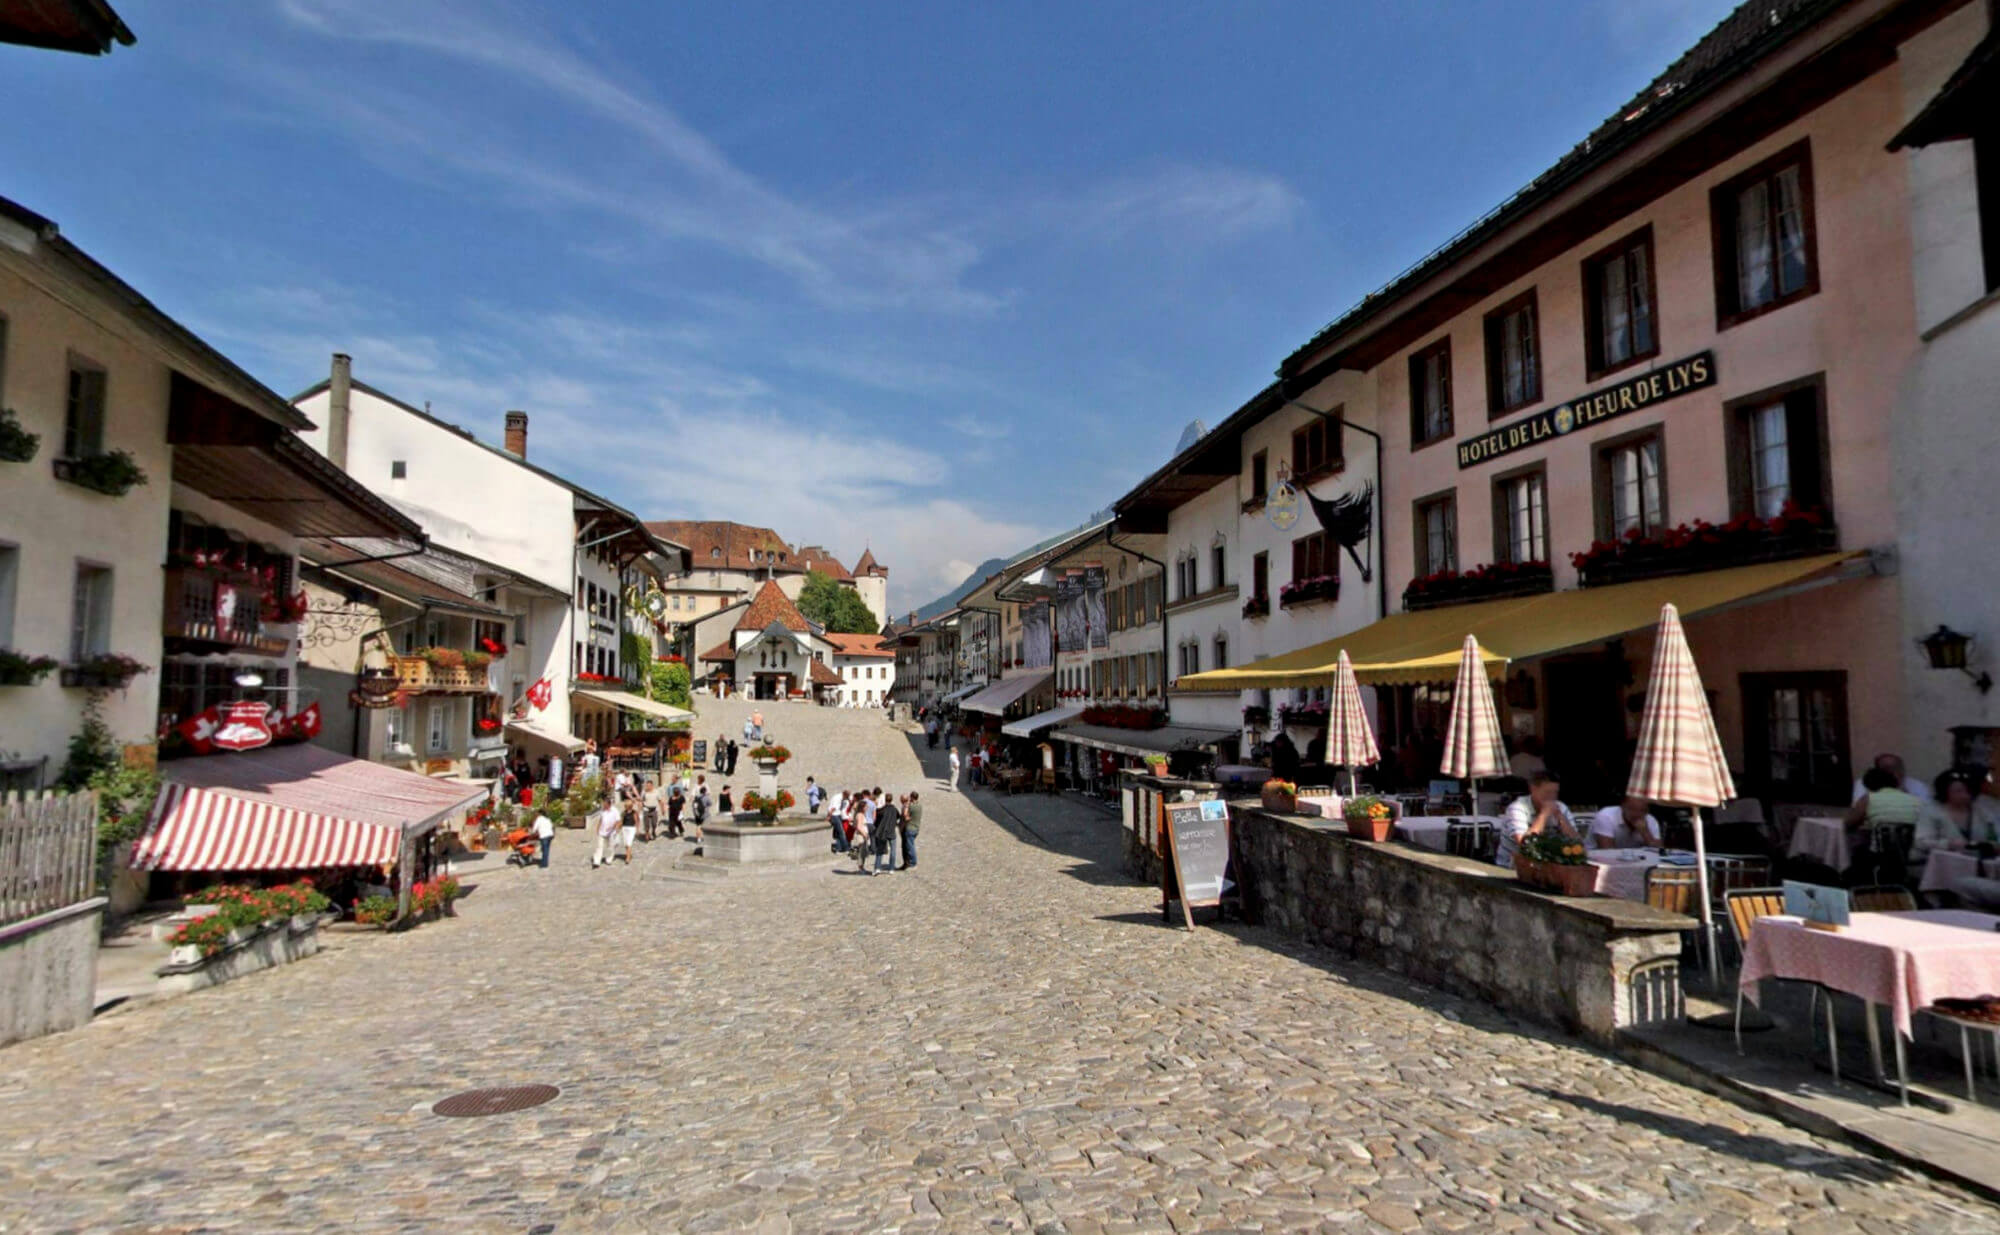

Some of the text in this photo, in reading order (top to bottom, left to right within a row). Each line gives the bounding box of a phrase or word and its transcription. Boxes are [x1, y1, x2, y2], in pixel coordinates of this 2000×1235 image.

[1460, 358, 1707, 465] HOTEL DE LA FLEUR DE LYS
